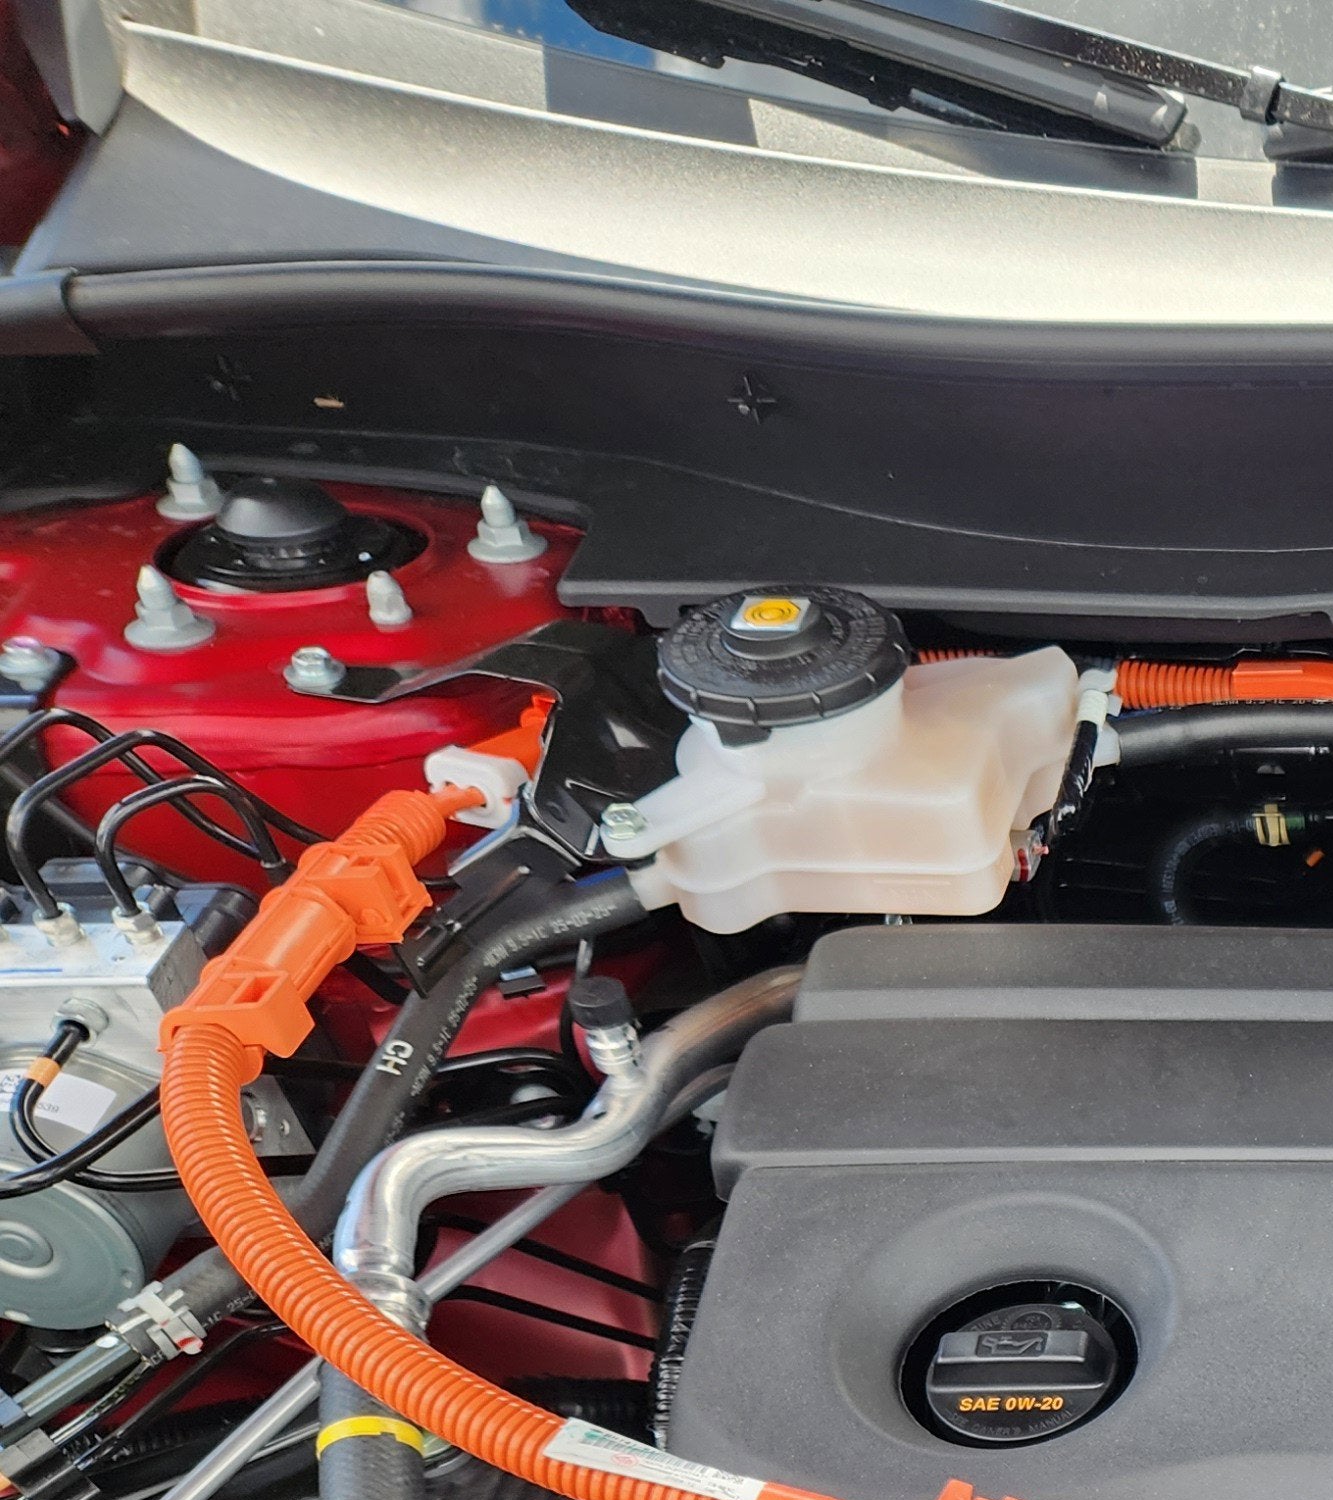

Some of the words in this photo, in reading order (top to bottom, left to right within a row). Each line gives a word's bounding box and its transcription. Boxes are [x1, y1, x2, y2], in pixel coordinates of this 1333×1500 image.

[375, 1039, 414, 1076] CH
[959, 1397, 1001, 1412] SAE
[1005, 1396, 1064, 1412] 0W-20
